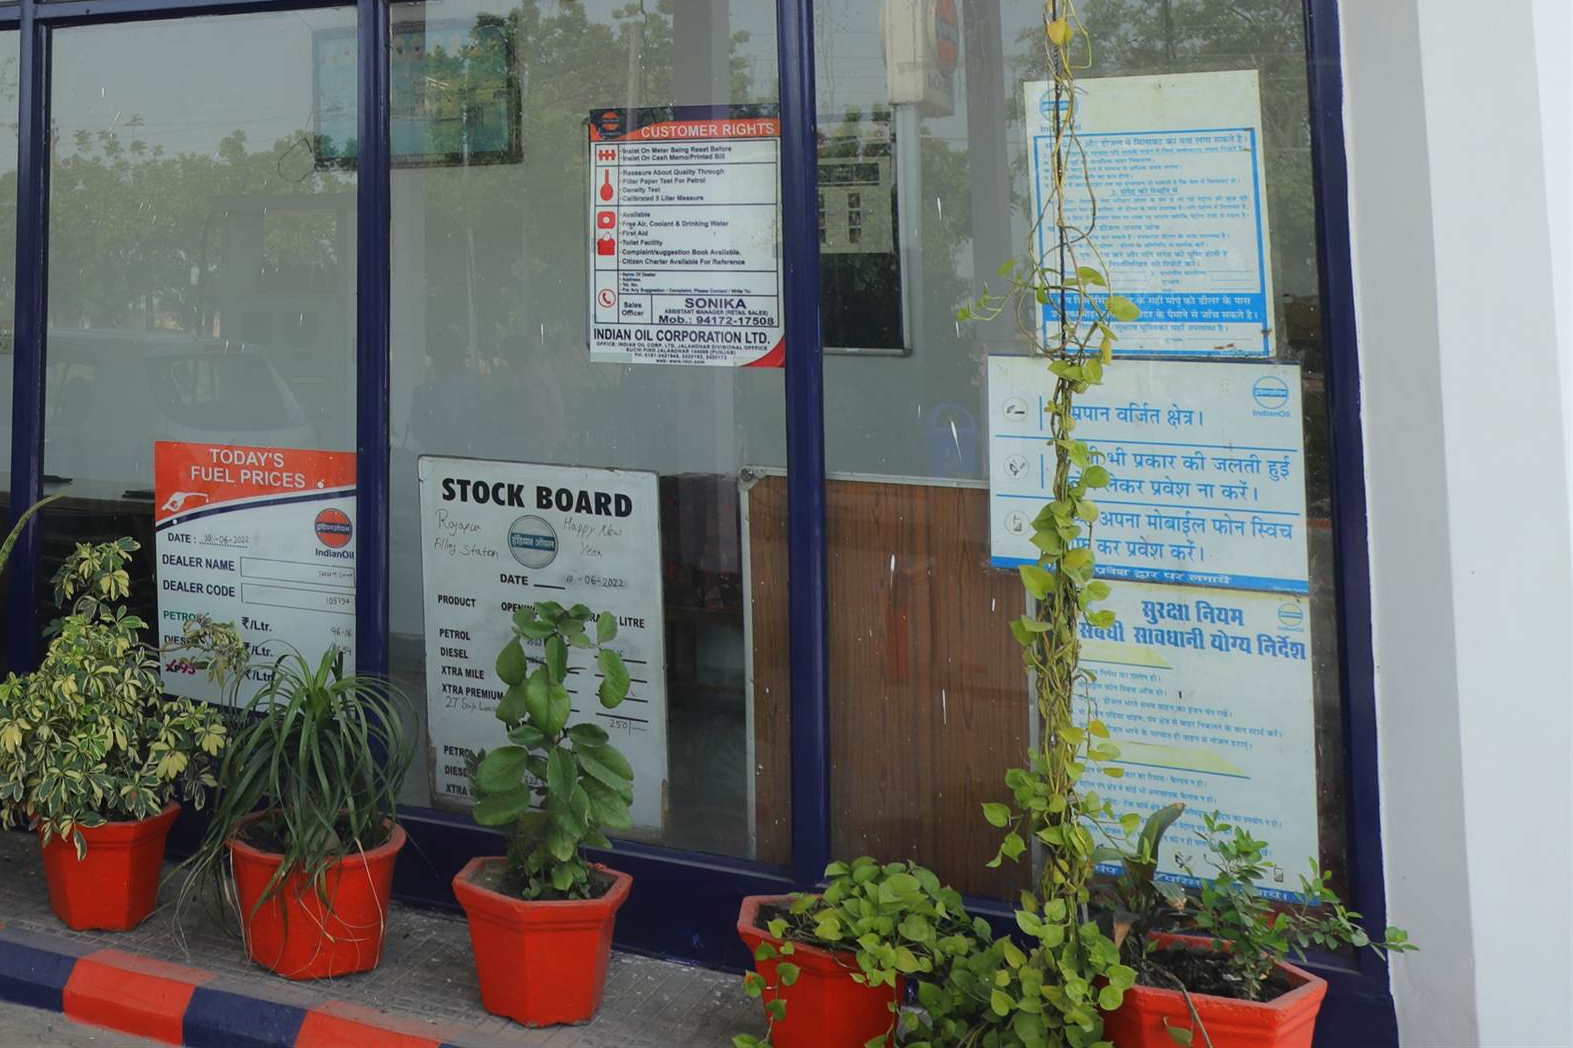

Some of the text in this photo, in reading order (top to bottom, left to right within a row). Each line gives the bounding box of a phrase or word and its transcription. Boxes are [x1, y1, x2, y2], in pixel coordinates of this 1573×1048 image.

[641, 123, 774, 138] CUSTOMER RIGHTS
[684, 298, 747, 309] SONIKA
[696, 316, 775, 326] 94172-17508
[593, 328, 771, 344] INDIAN OIL CORPORATION LTD.
[1071, 404, 1110, 422] म्रपान
[1115, 401, 1161, 425] वर्जित
[209, 448, 285, 468] TODAY'S
[1107, 447, 1127, 467] भी
[1133, 451, 1175, 471] प्रकार
[1180, 450, 1206, 471] की
[1211, 452, 1261, 474] जलती
[190, 465, 306, 488] FUEL PRICES
[1149, 477, 1190, 498] प्रवेश
[442, 477, 633, 517] STOCK BOARD
[1099, 508, 1294, 540] अपना मोबाईल फोन स्विच
[167, 532, 191, 544] DATE
[1096, 534, 1122, 556] कर
[1126, 535, 1164, 559] प्रवेश
[162, 553, 236, 572] DEALER NAME
[315, 548, 355, 560] IndianOil
[162, 579, 236, 597] DEALER CODE
[499, 573, 529, 586] DATE
[163, 610, 197, 622] PETRO
[437, 594, 645, 629] PRODUCT LITRE
[1141, 599, 1244, 626] सुरक्षा नियम
[164, 635, 188, 645] DIES
[439, 628, 471, 641] PETROL
[1133, 625, 1307, 660] सावधानी योग्य निर्देश
[440, 646, 469, 659] DIESEL
[441, 665, 485, 680] XTRA MILE
[442, 683, 504, 700] XTRA PREMIUM
[446, 783, 468, 796] XTRA
